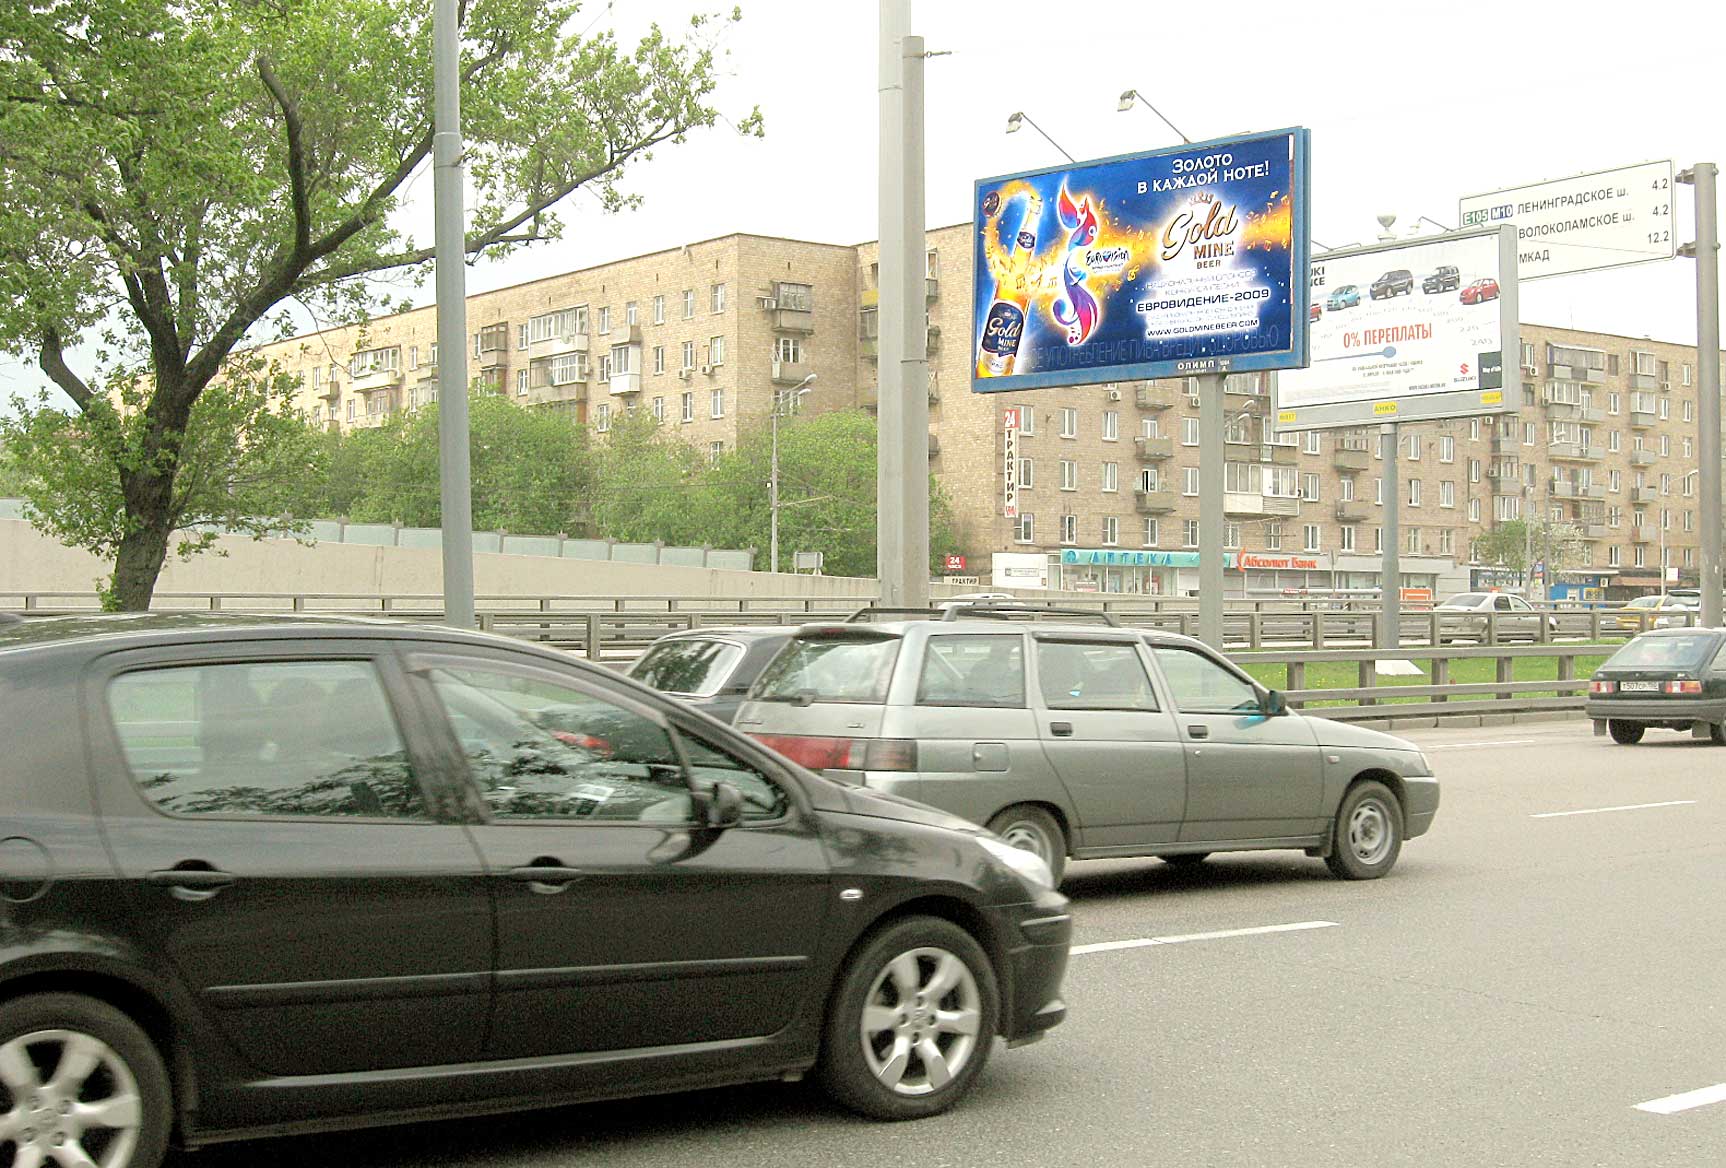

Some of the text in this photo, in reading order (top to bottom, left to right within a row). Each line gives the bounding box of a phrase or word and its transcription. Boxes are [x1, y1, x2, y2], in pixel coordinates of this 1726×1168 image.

[1172, 153, 1233, 174] ЗОЛОТО
[1137, 160, 1269, 194] В КАЖДОЙ НОТЕ!
[1517, 187, 1614, 214] ЛЕНИНГРАДСКОЕ
[1651, 178, 1668, 190] 4.2
[1161, 201, 1239, 261] Gold
[1519, 212, 1619, 239] ВОЛОКОЛАМСКОЕ
[1652, 205, 1669, 216] 4.2
[1193, 240, 1235, 260] MINE
[1519, 231, 1669, 264] МКАД 12.2
[1196, 259, 1221, 270] BEER
[1137, 288, 1269, 312] ЕВРОВИДЕНИЕ-2009
[987, 317, 1021, 337] Gold
[1147, 319, 1258, 337] WWW.GOLDMINEBEER.COM
[1343, 331, 1360, 348] 0%
[1364, 323, 1432, 345] ПЕРЕПЛАТЫ
[998, 337, 1016, 347] MINE
[1177, 360, 1215, 370] ОЛИМП
[1004, 411, 1016, 427] 24
[1006, 429, 1016, 502] ТРАКТИР
[949, 556, 960, 564] 24
[1090, 552, 1172, 565] АПТЕКА
[1244, 556, 1317, 569] Абсолют Банк
[952, 577, 977, 585] ТРАКТИР
